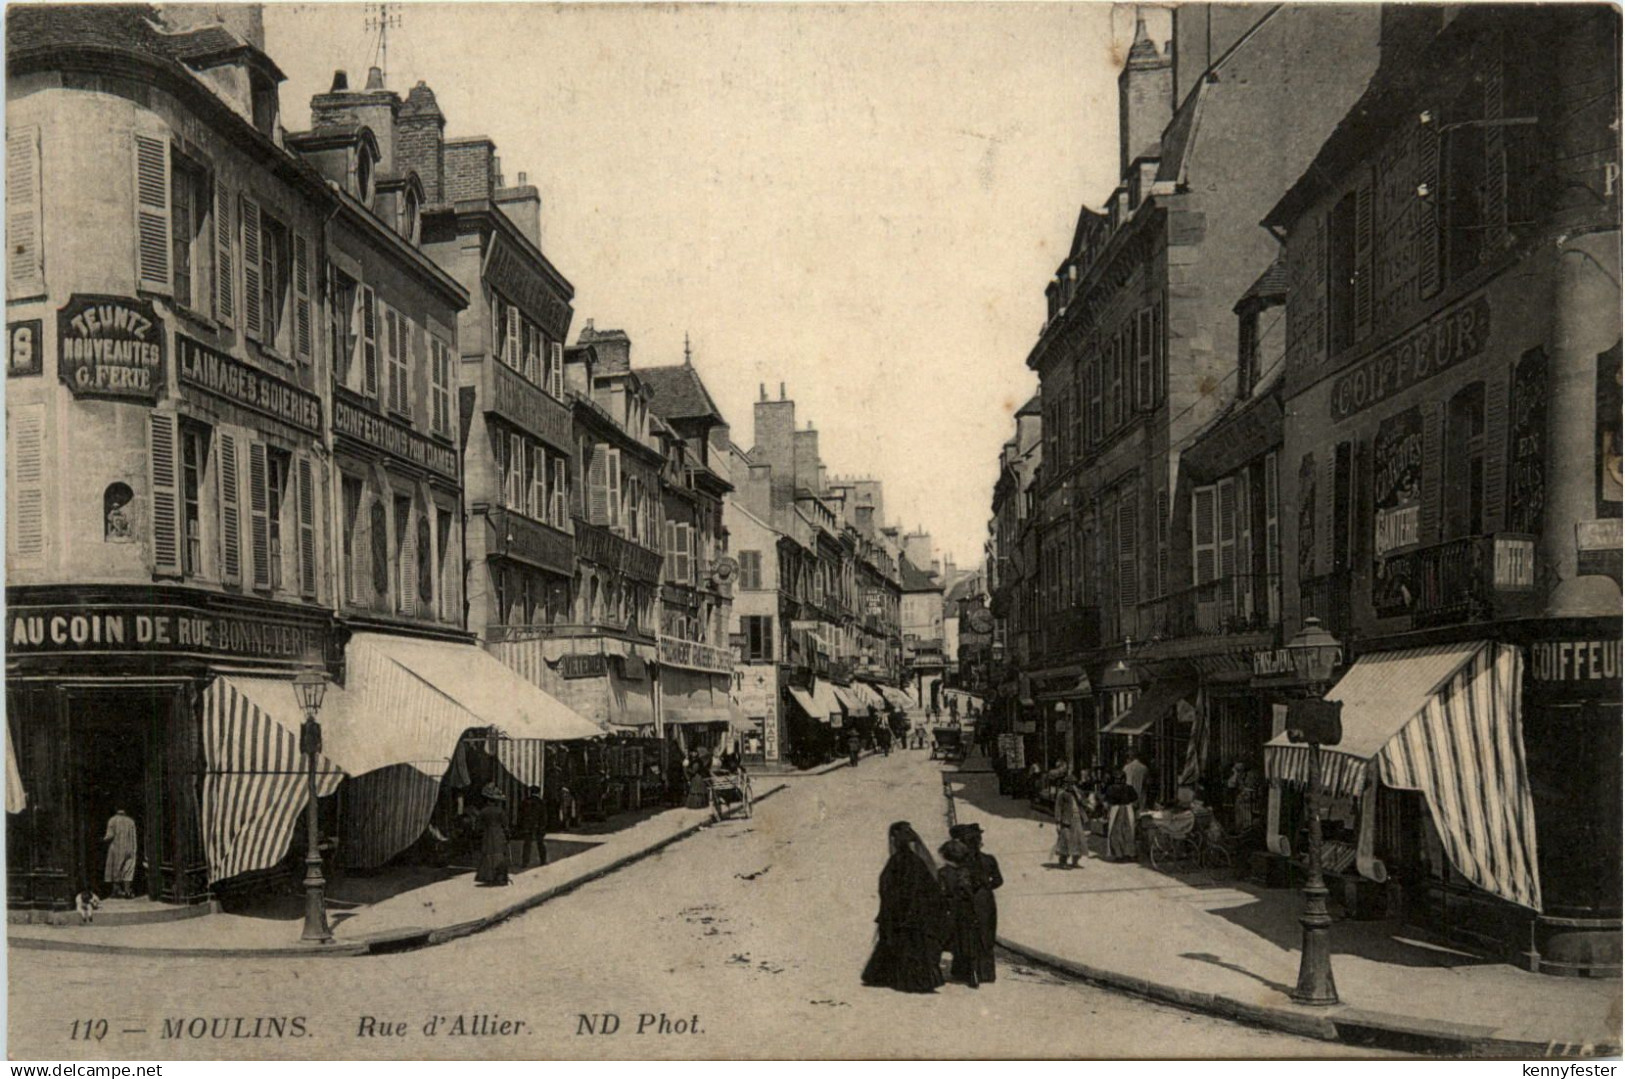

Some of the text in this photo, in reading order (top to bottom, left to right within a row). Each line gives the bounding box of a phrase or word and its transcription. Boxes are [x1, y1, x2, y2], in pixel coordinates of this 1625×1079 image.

[71, 305, 152, 339] TEUNTZ
[64, 338, 159, 365] NOUVEAUTES
[1339, 307, 1476, 414] COIFFEUR
[336, 402, 408, 455] CONFECTIONS
[427, 443, 455, 476] DAMES
[13, 616, 315, 657] AU COIN DE RUE BONNETERIE
[766, 694, 775, 757] PHARMACIE
